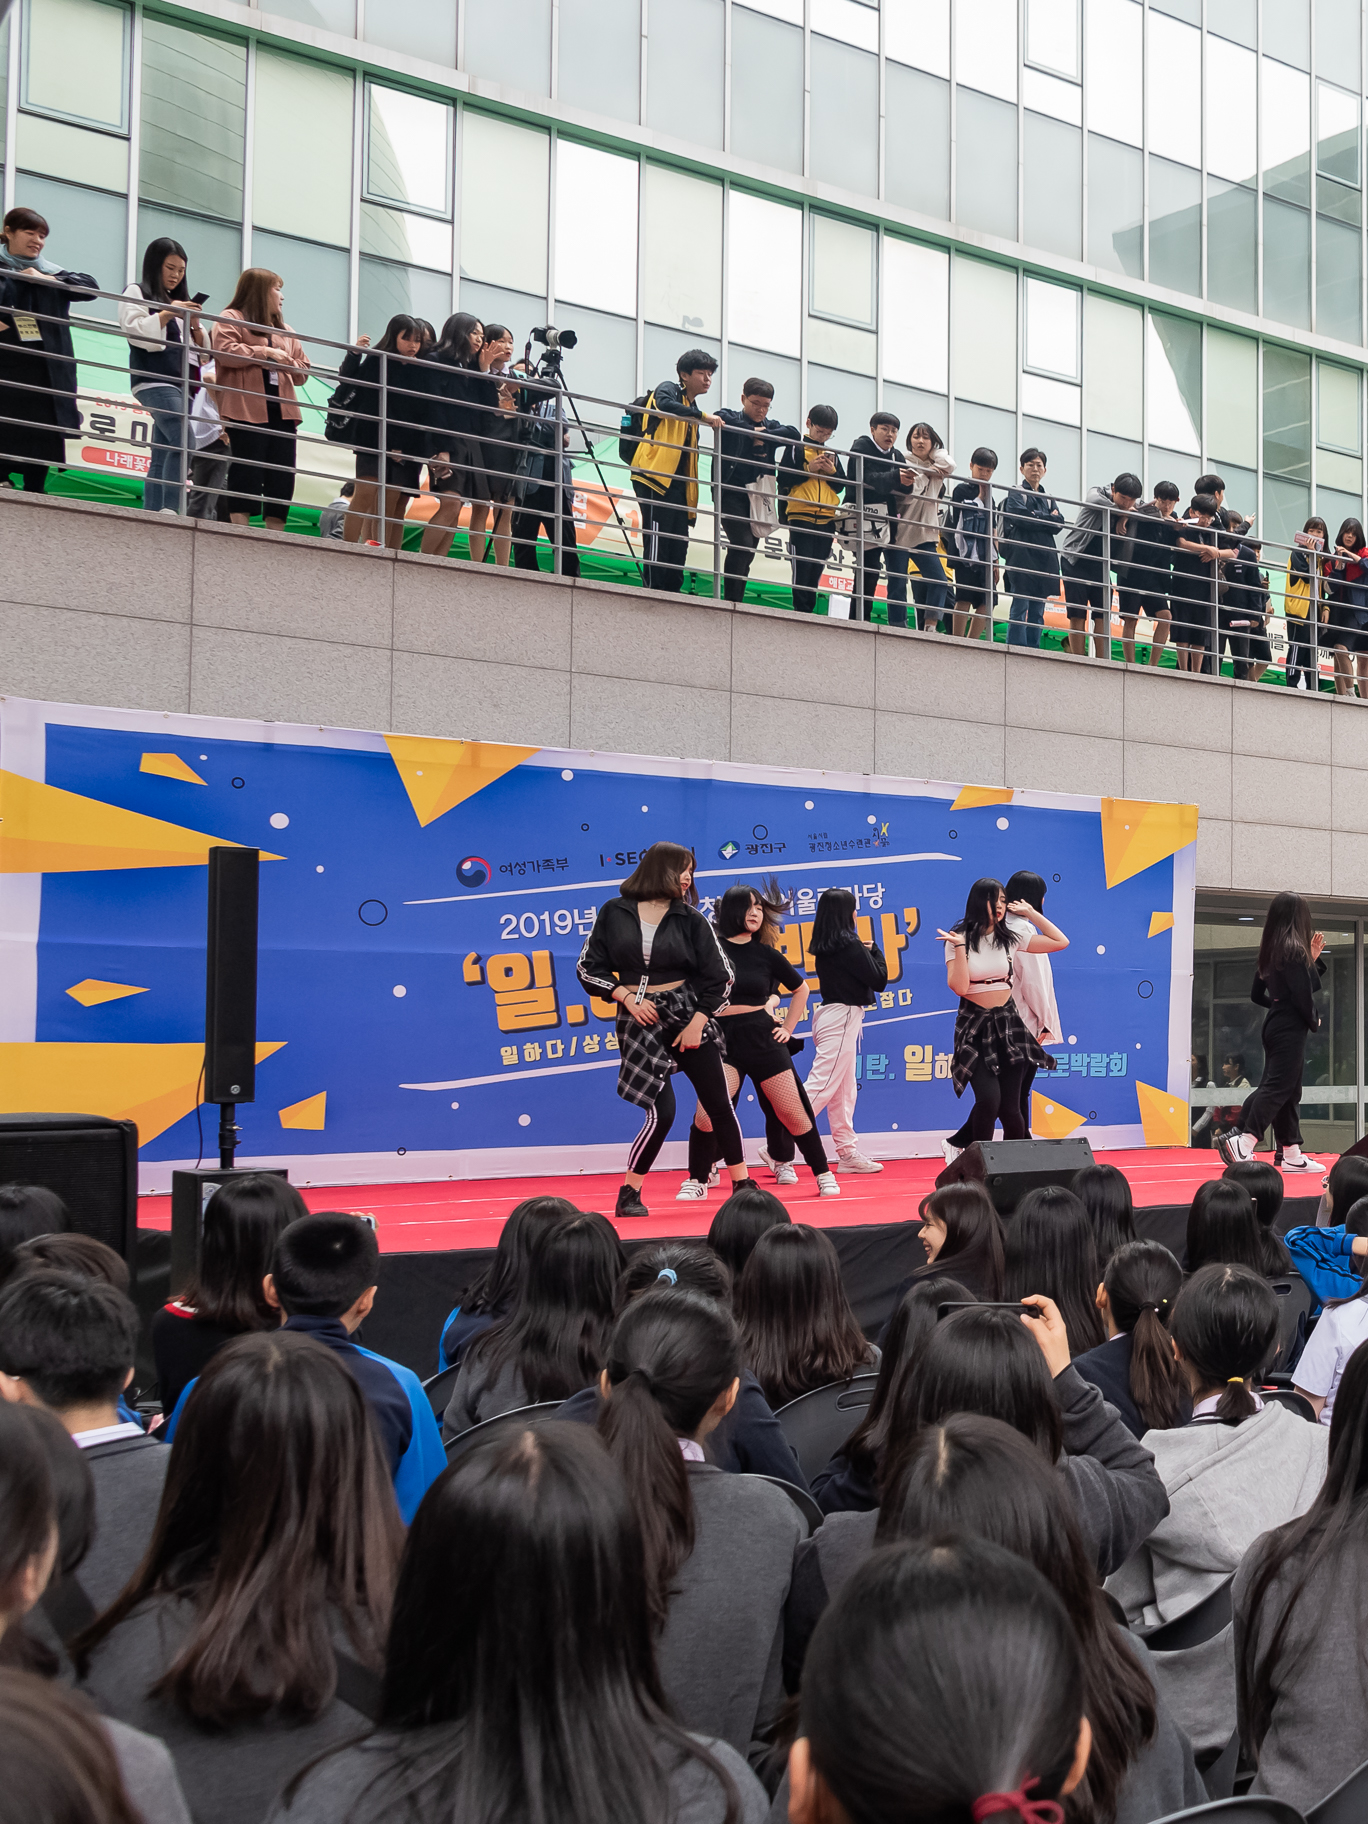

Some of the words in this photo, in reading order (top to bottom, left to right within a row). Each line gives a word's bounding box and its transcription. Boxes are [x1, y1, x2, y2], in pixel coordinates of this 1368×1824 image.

[745, 841, 787, 855] 광진구
[499, 856, 570, 876] 여성가족부
[1033, 1051, 1129, 1079] 로박람회
